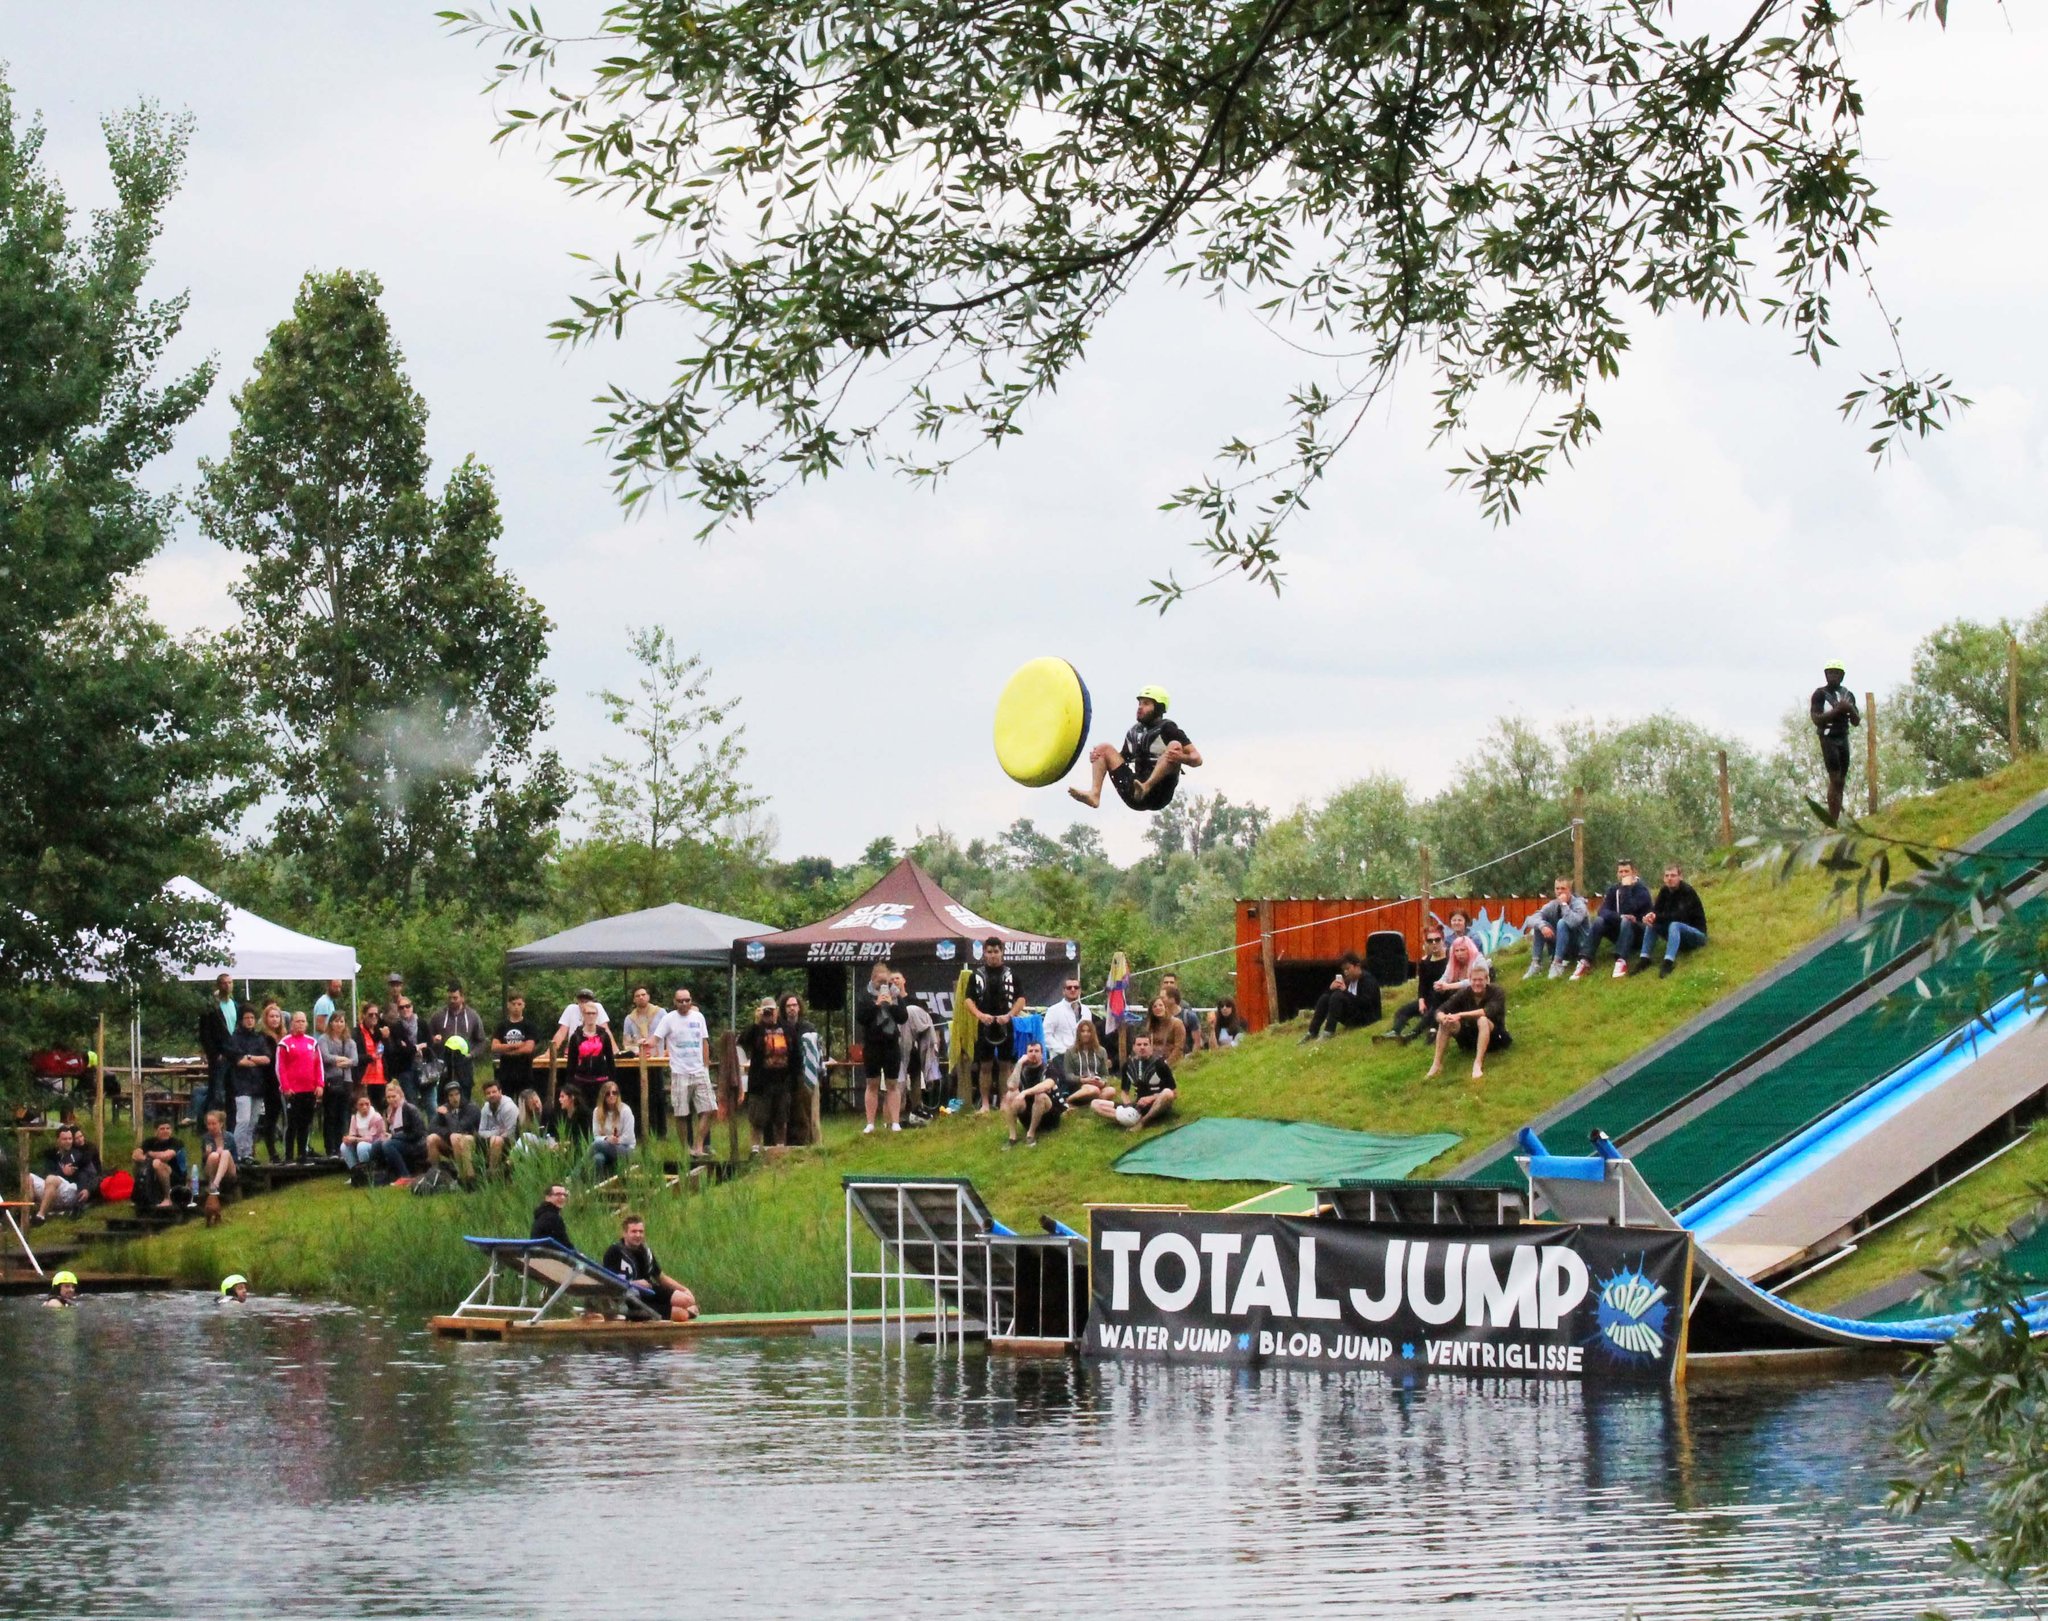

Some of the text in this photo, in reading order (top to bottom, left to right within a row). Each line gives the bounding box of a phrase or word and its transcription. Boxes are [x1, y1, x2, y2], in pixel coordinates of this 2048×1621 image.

[807, 941, 895, 956] SLIDE BOX
[1004, 941, 1047, 955] SLIDE BOX
[1100, 1230, 1589, 1330] TOTAL JUMP
[1099, 1323, 1584, 1373] WATER JUMP BLOB JUMP VENTRIGLISSE
